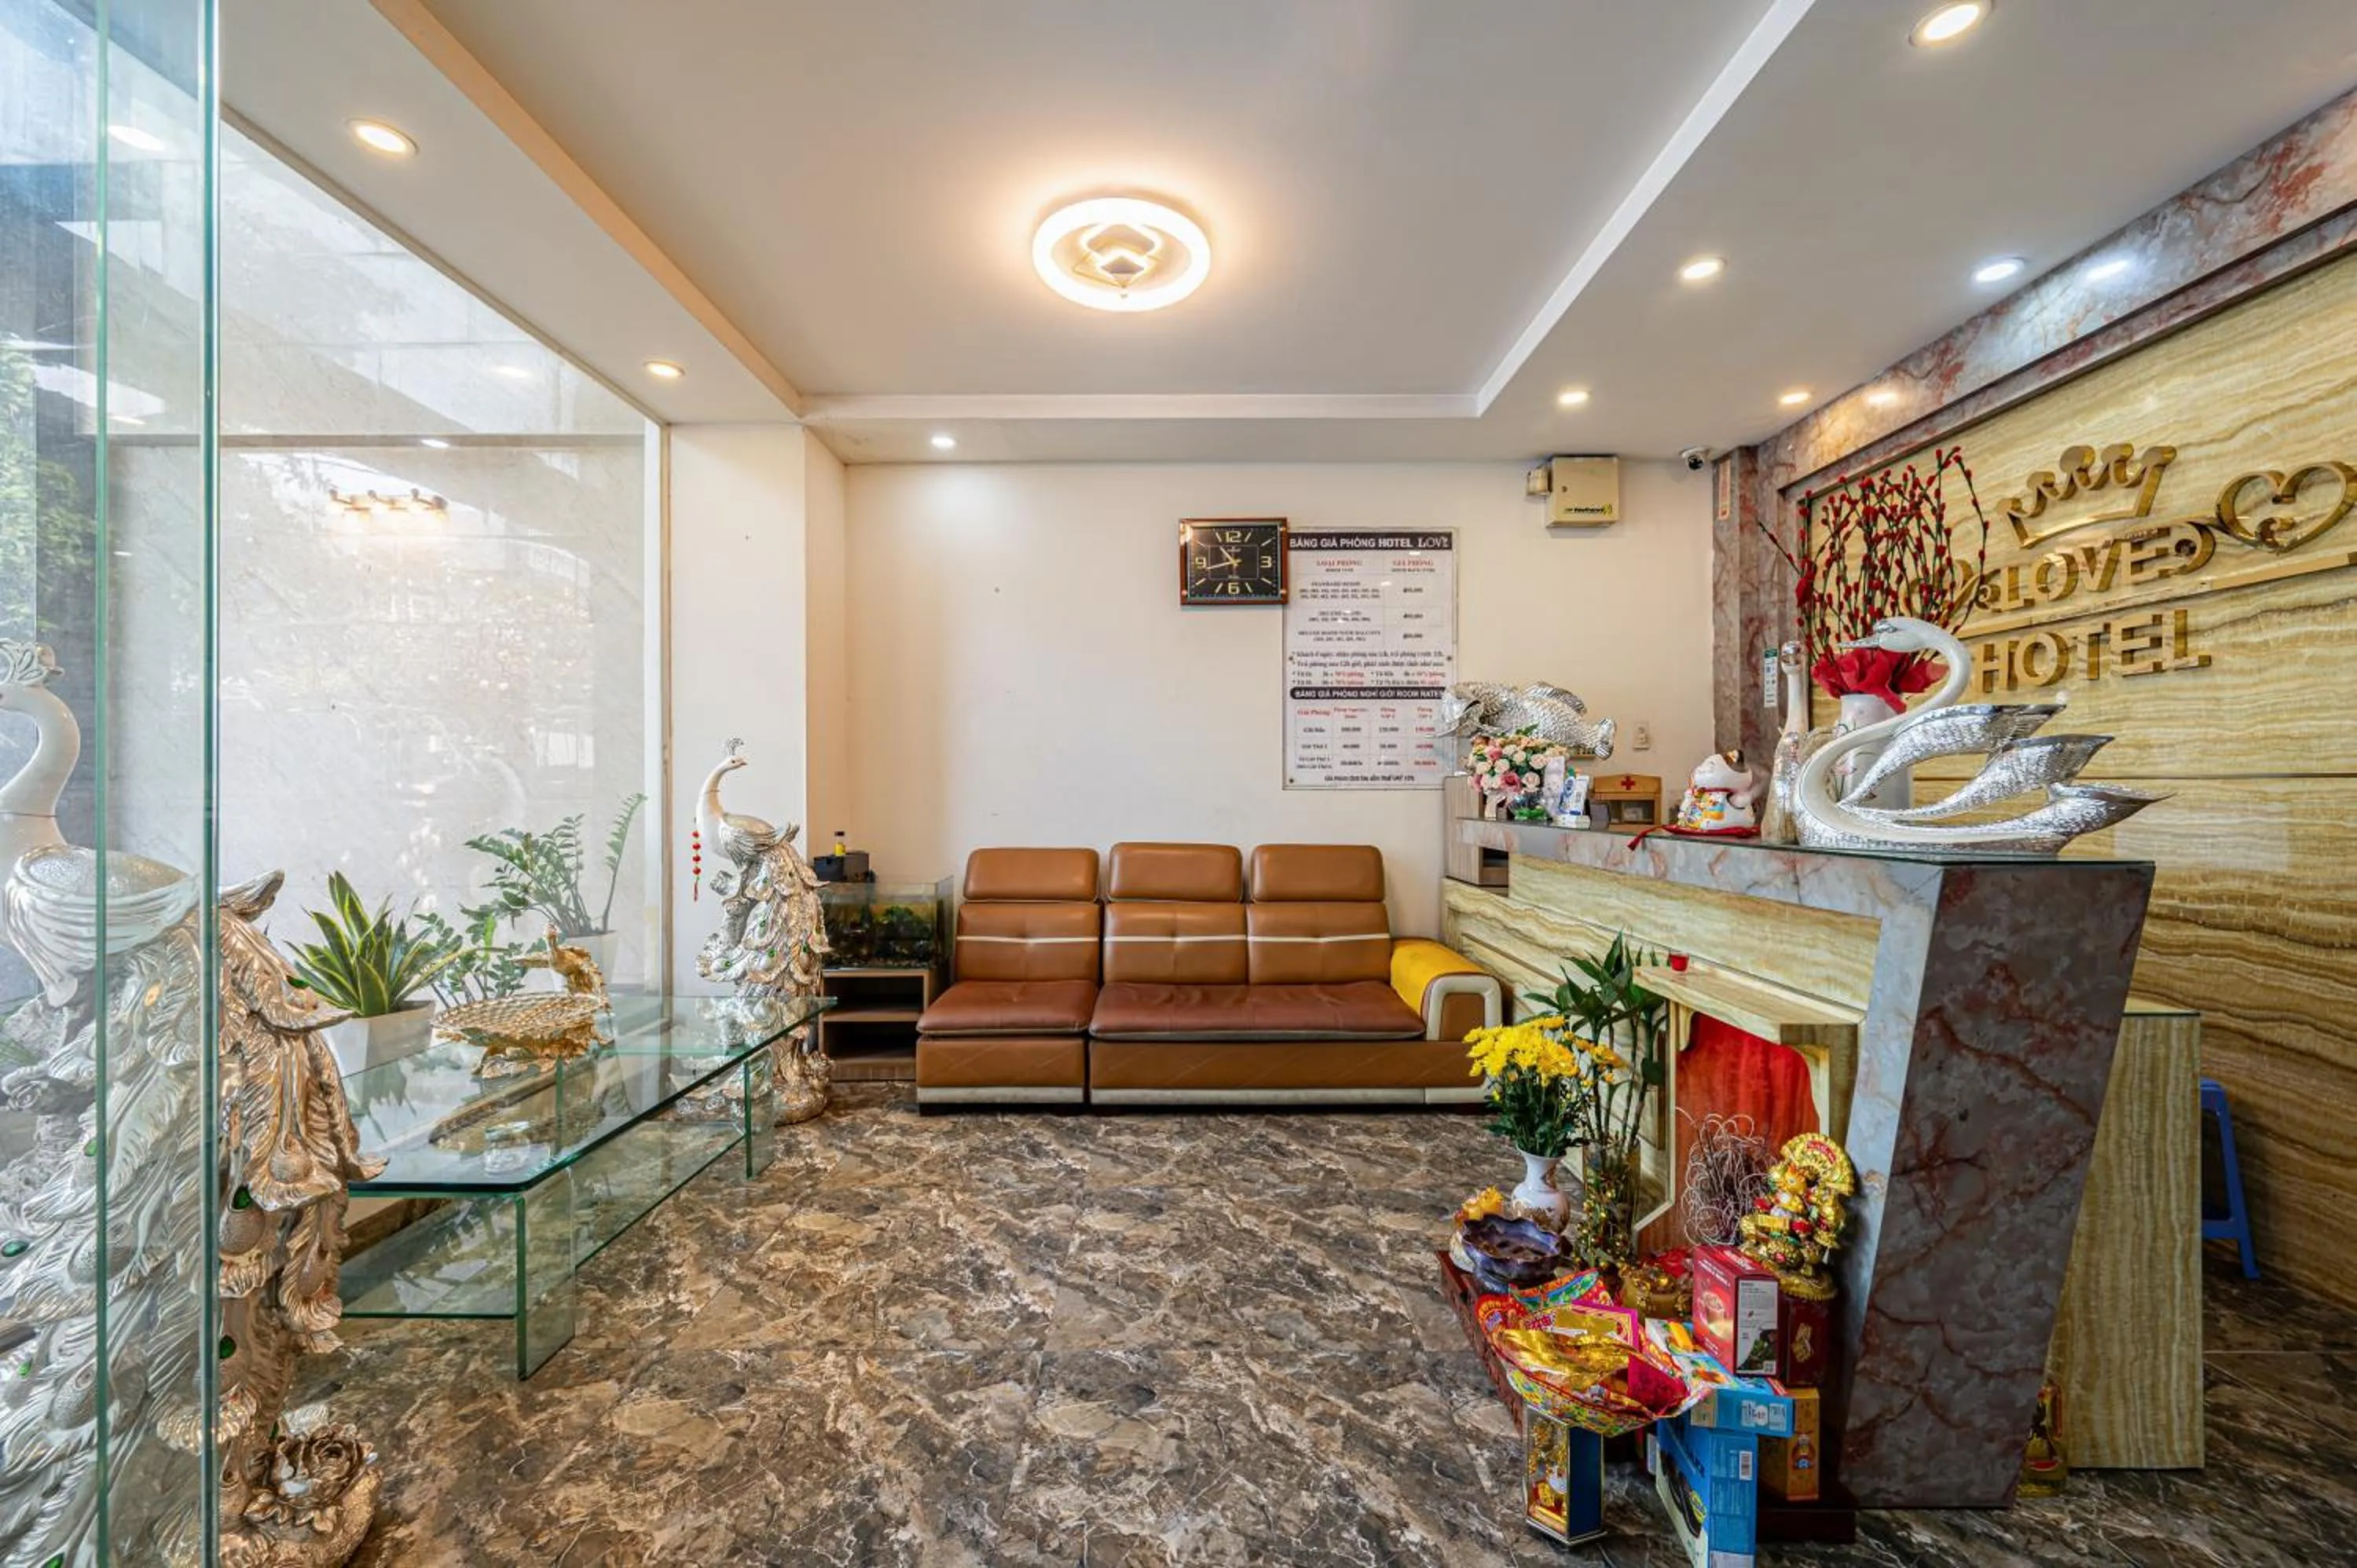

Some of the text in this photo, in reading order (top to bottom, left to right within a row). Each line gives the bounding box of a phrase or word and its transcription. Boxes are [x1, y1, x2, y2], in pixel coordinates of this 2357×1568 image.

[1226, 530, 1241, 543] 12
[1378, 538, 1413, 548] HOTEL
[1195, 556, 1207, 569] 9
[1260, 555, 1272, 569] 3
[1998, 527, 2173, 613] LOVE
[1228, 582, 1240, 595] 6
[1972, 609, 2213, 694] HOTEL
